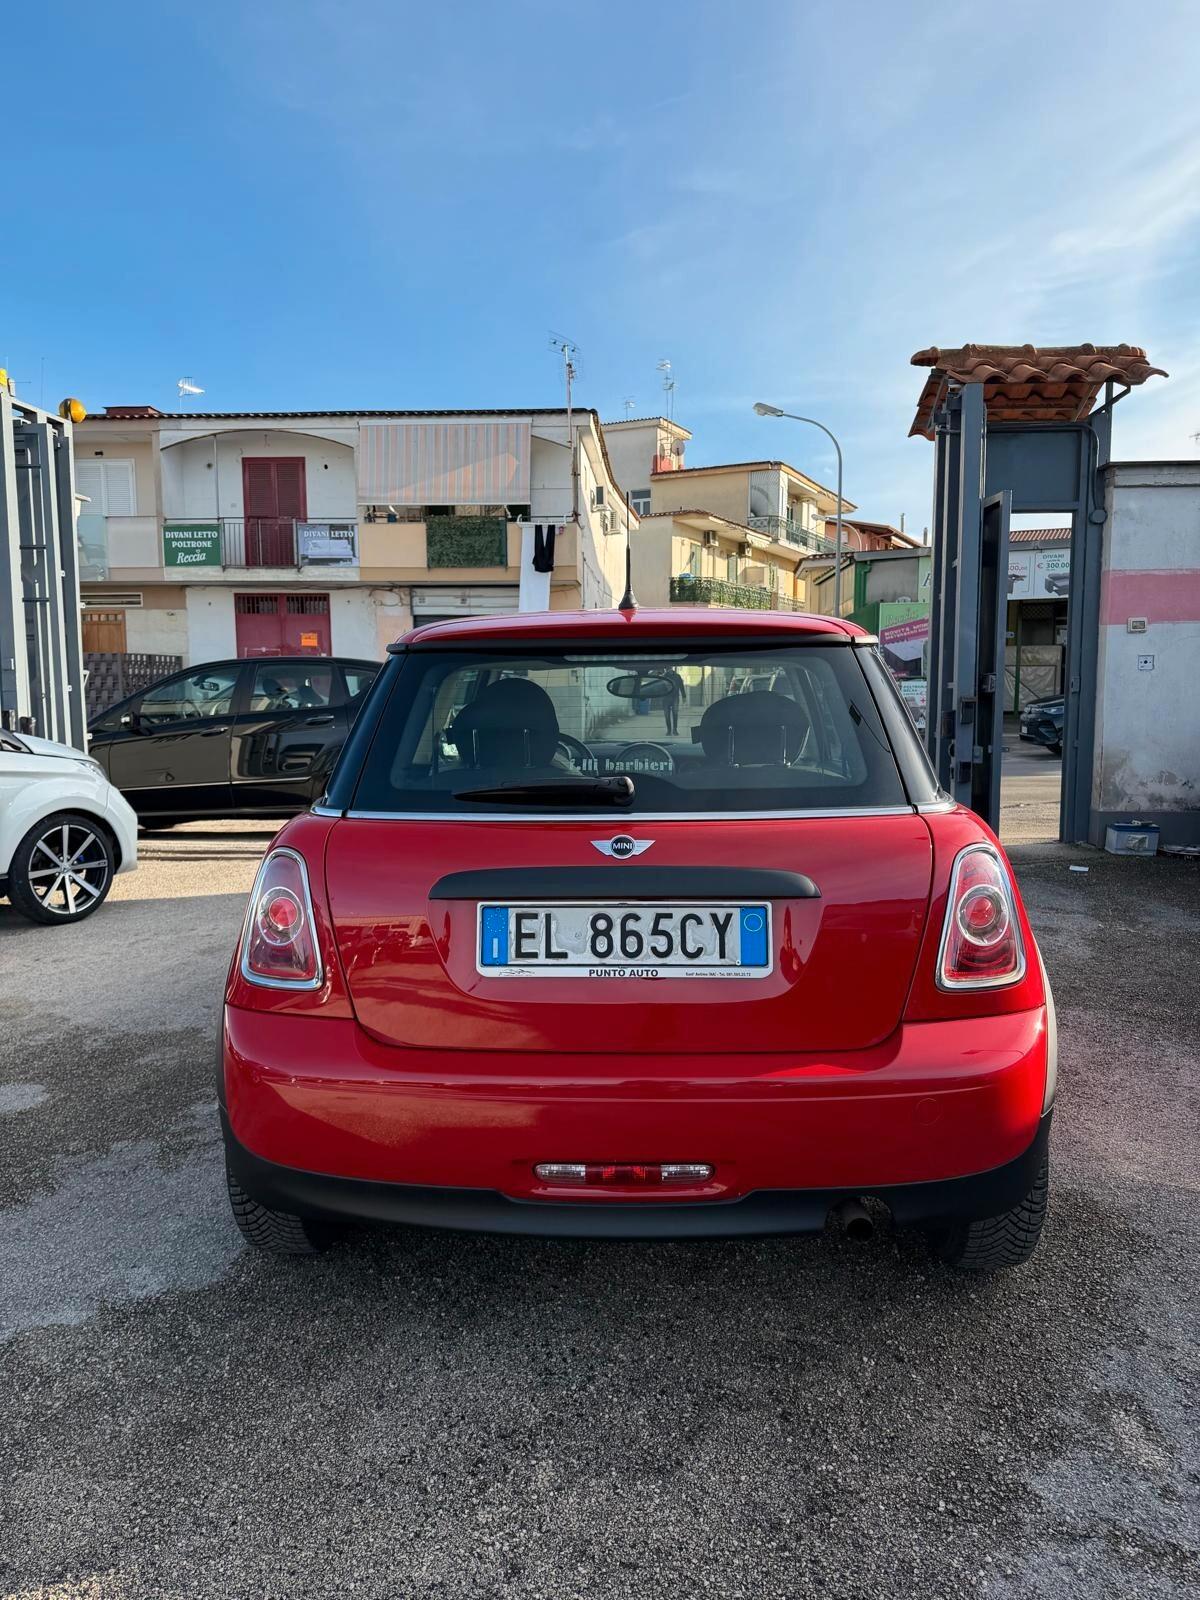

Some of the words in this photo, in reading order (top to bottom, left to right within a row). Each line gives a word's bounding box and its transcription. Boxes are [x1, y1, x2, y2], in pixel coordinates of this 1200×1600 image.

[165, 531, 193, 539] DIVANI
[193, 531, 218, 539] LETTO
[303, 530, 330, 538] DIVANI
[171, 540, 213, 548] POLTRONE
[176, 549, 207, 564] Reccia
[605, 758, 673, 771] barbieri
[612, 842, 633, 850] MINI
[515, 912, 569, 959] EL
[590, 912, 734, 959] 865CY
[588, 969, 626, 977] PUNTO
[629, 969, 659, 977] AUTO
